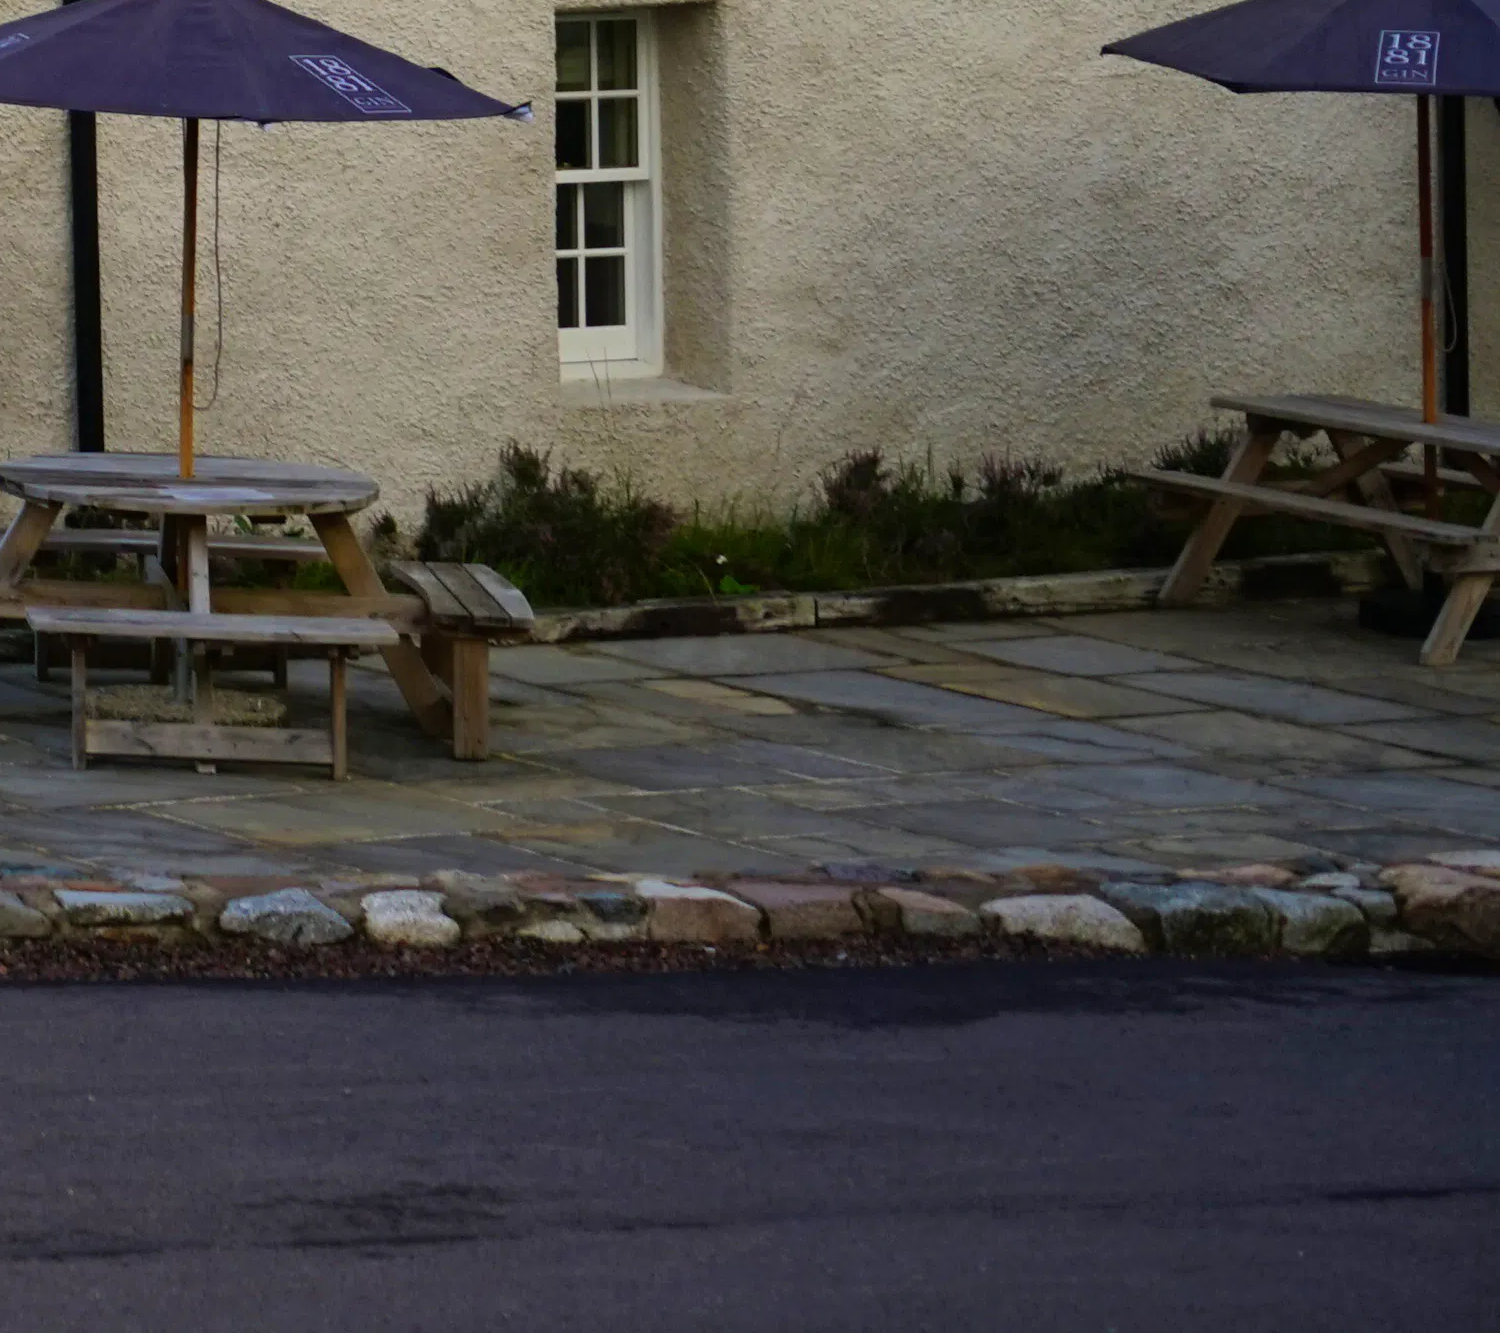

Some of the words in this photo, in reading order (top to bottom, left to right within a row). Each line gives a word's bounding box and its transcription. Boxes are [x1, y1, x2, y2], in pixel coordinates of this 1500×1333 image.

[1388, 33, 1432, 49] 18
[1384, 48, 1427, 65] 81
[302, 58, 352, 76] 18
[1382, 68, 1428, 81] GIN
[325, 74, 375, 92] 81
